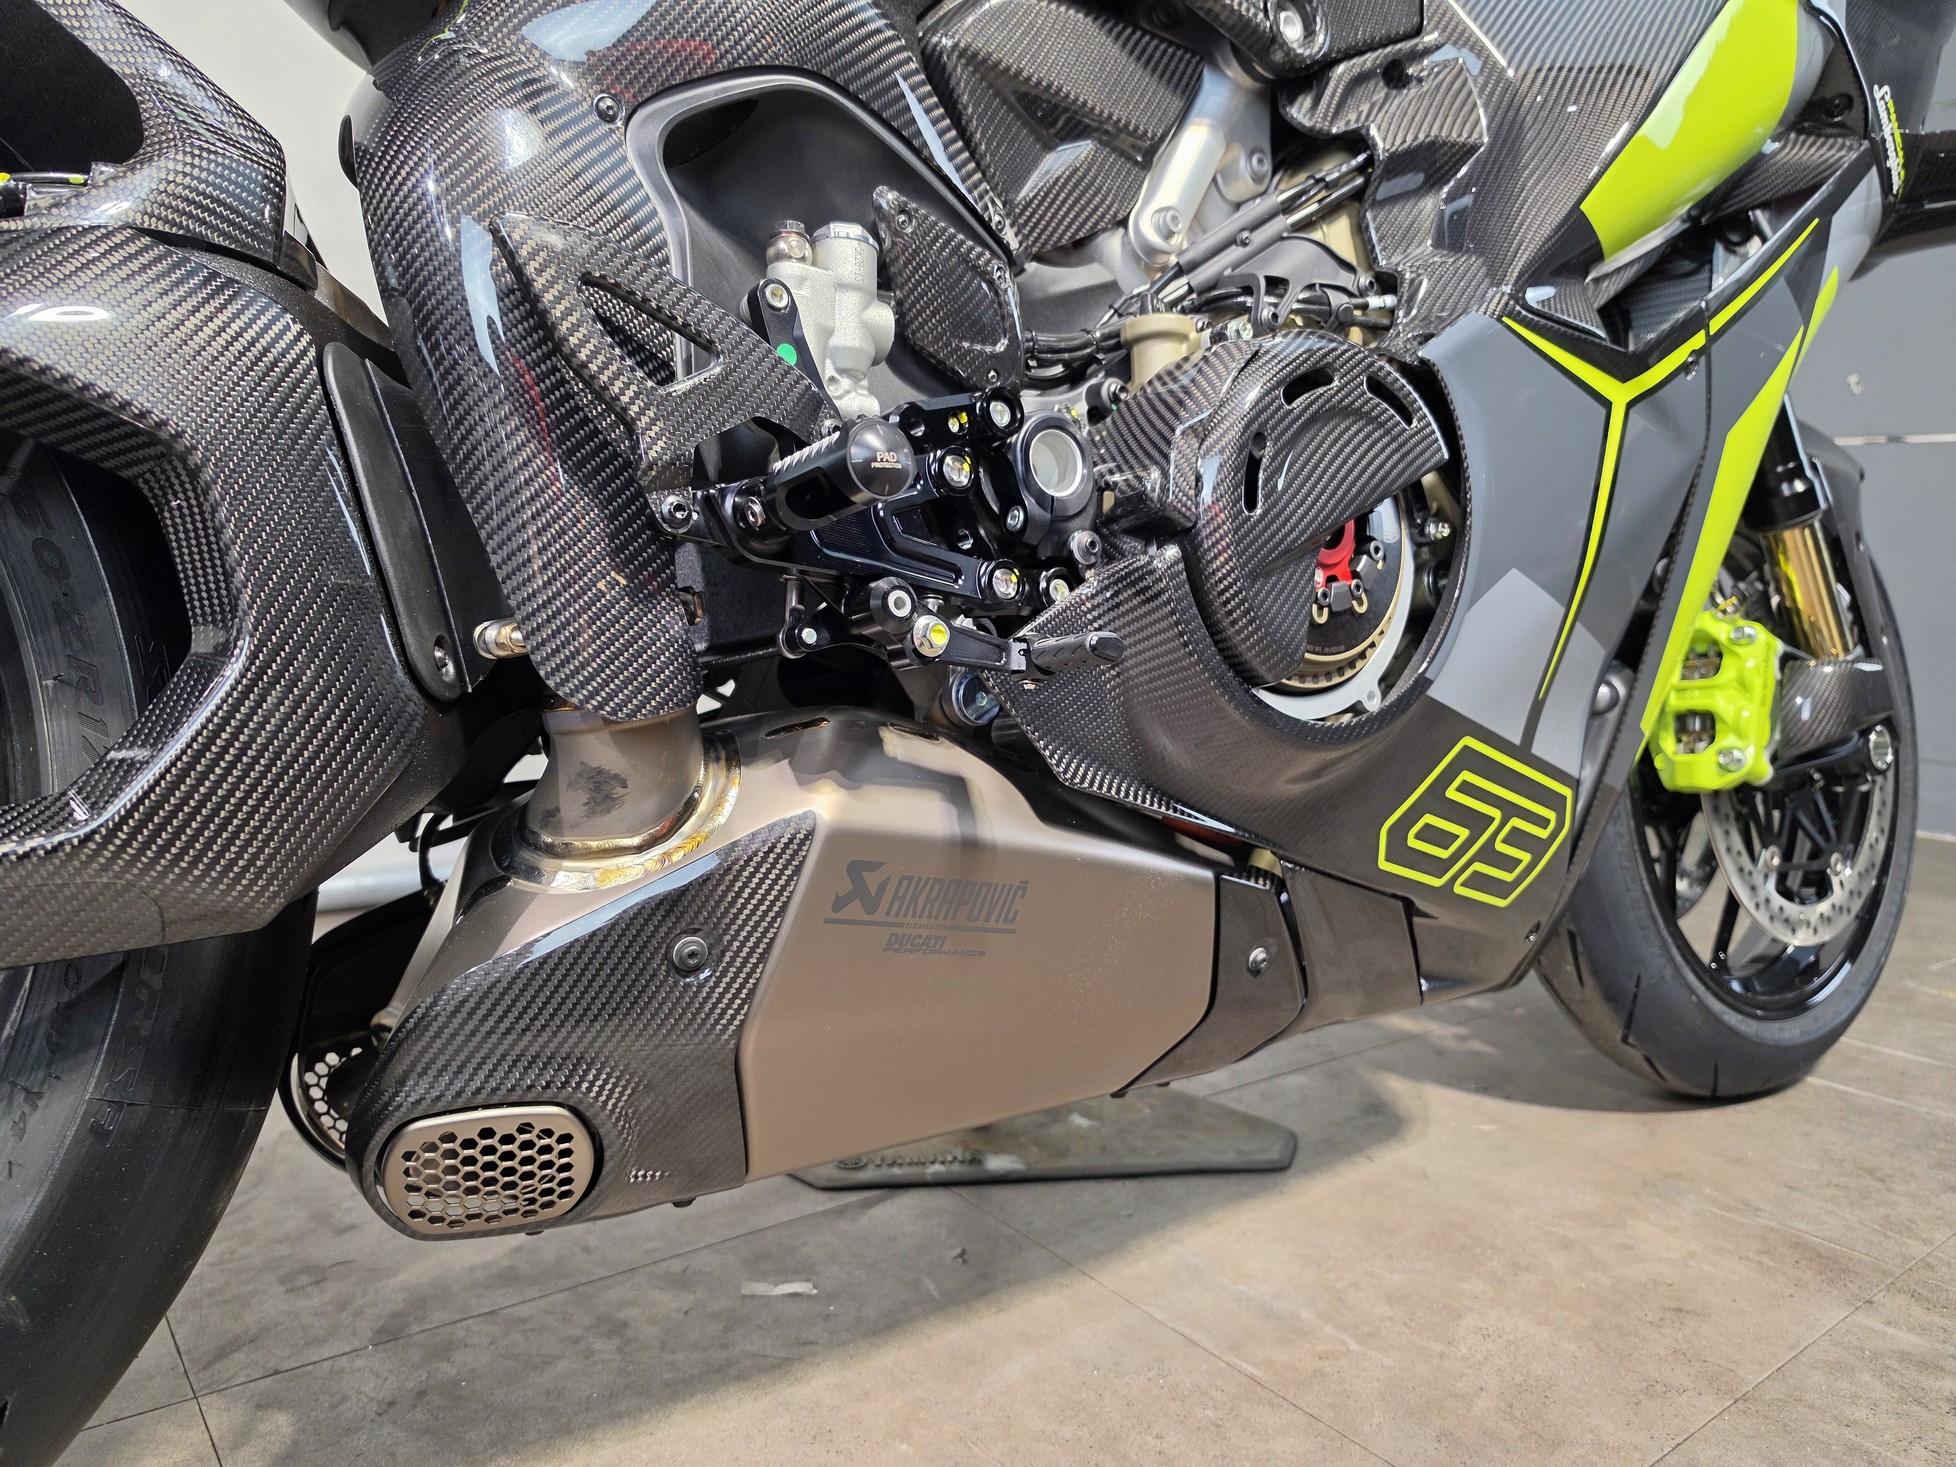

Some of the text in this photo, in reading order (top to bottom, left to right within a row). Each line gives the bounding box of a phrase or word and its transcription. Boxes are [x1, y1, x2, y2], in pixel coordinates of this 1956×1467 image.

[876, 451, 897, 462] PAD
[1377, 735, 1573, 908] 63
[885, 932, 948, 949] DUCATI
[882, 946, 987, 957] PERFORMANCE
